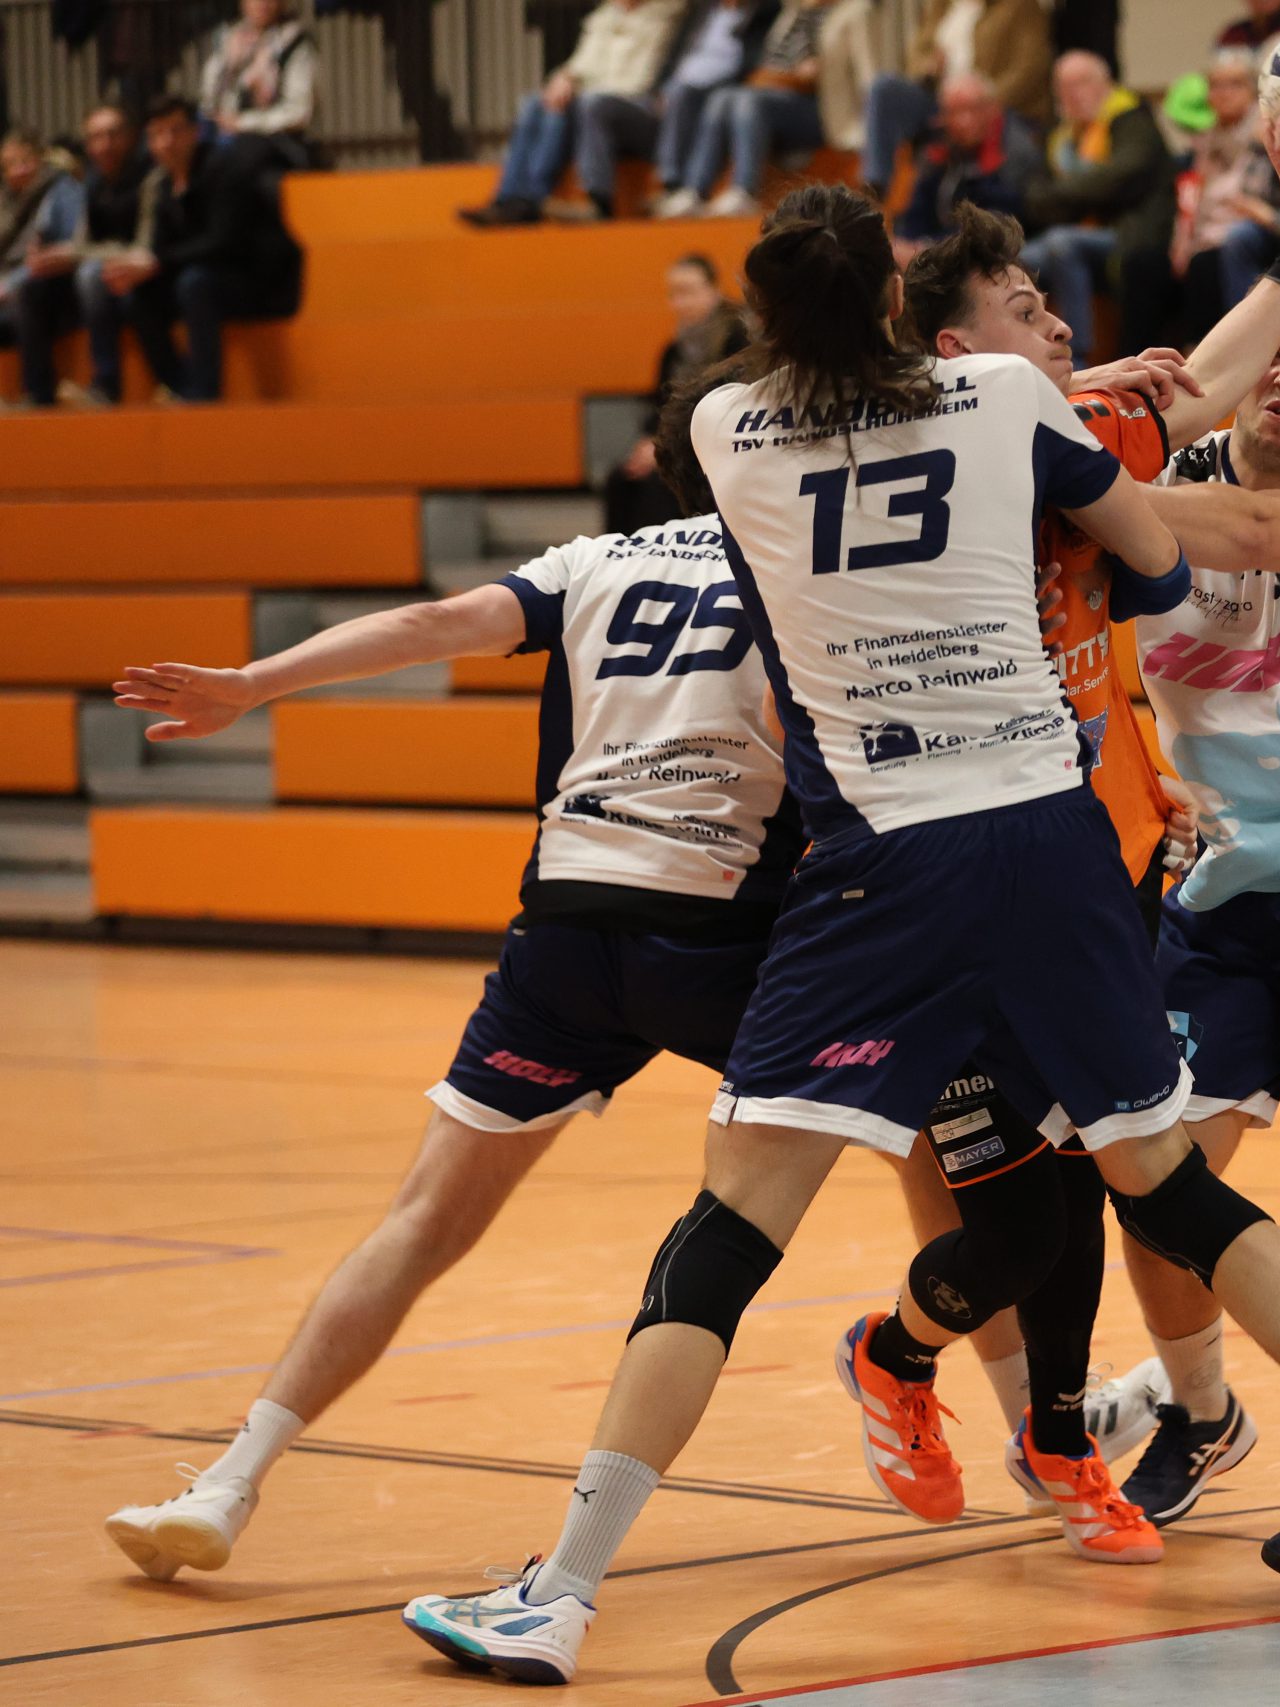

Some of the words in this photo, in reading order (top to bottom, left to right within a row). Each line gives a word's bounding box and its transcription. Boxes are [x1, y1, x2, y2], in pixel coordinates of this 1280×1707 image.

[732, 438, 765, 453] TSV
[798, 448, 956, 575] 13
[614, 530, 723, 549] HAND
[595, 580, 754, 680] 95
[825, 642, 848, 657] Ihr
[854, 622, 1008, 653] Finanzdienstleister
[867, 658, 883, 670] in
[888, 643, 981, 667] Heidelberg
[603, 742, 621, 755] Ihr
[622, 756, 634, 767] in
[955, 1141, 1000, 1165] MAYER
